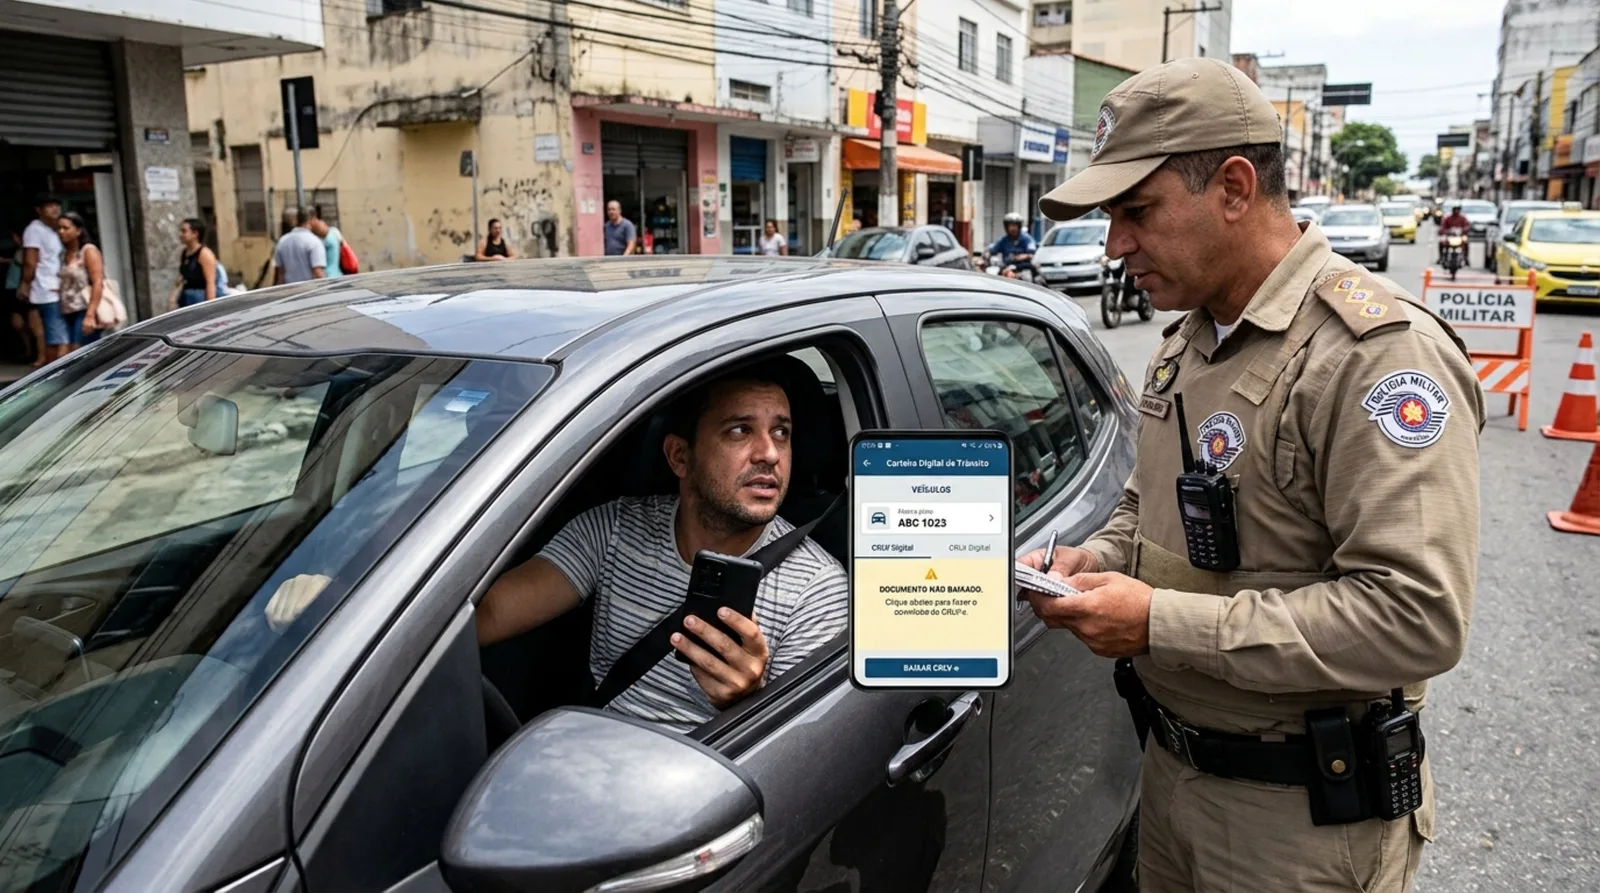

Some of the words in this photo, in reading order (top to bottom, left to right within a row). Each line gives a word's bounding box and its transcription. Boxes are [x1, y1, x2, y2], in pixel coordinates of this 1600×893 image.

[1440, 290, 1516, 306] POLÍCIA
[1439, 308, 1516, 322] MILITAR
[886, 459, 918, 468] Carteira
[919, 459, 944, 469] Digital
[945, 459, 956, 468] de
[898, 518, 920, 528] ABC
[922, 518, 947, 528] 1023
[879, 585, 928, 594] DOCUMENTO
[934, 599, 951, 608] para
